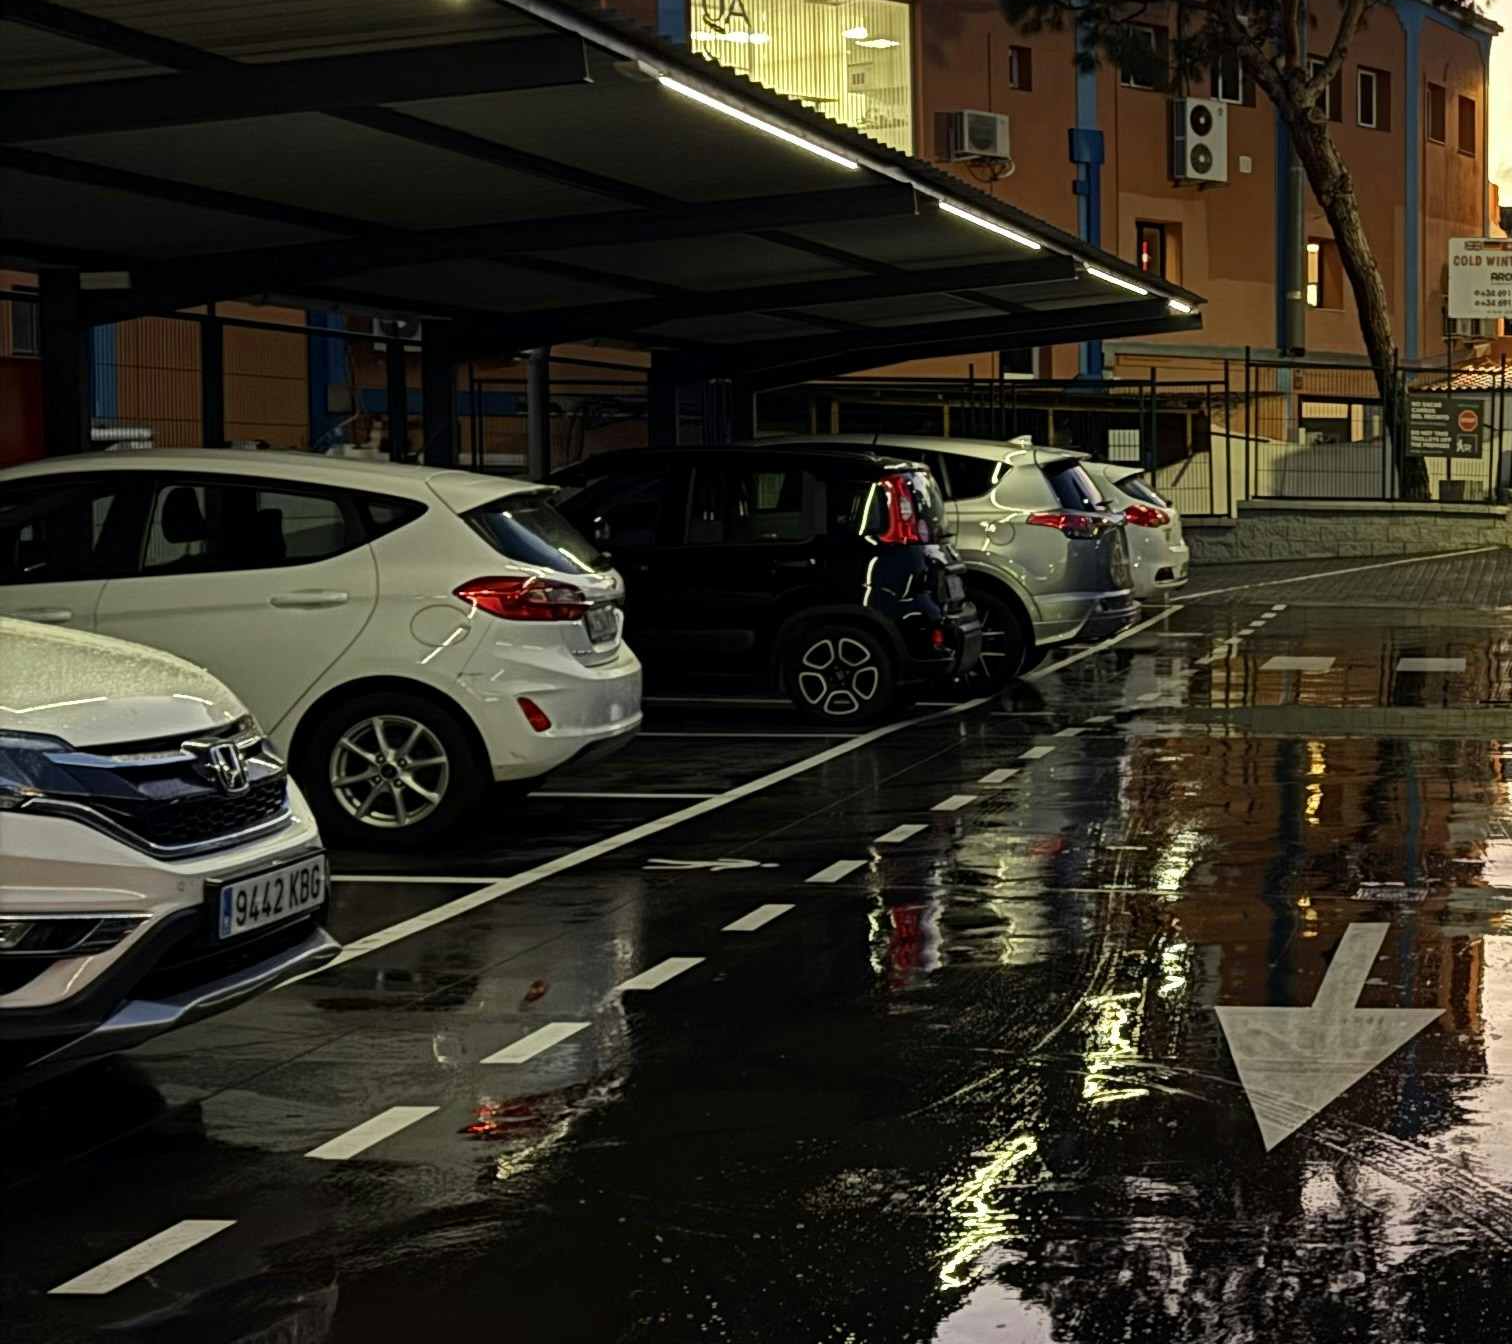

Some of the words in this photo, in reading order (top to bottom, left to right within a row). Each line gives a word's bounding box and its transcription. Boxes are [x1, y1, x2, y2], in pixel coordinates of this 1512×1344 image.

[1453, 256, 1482, 266] COLD
[236, 878, 284, 927] 9442
[289, 864, 320, 909] KBG
